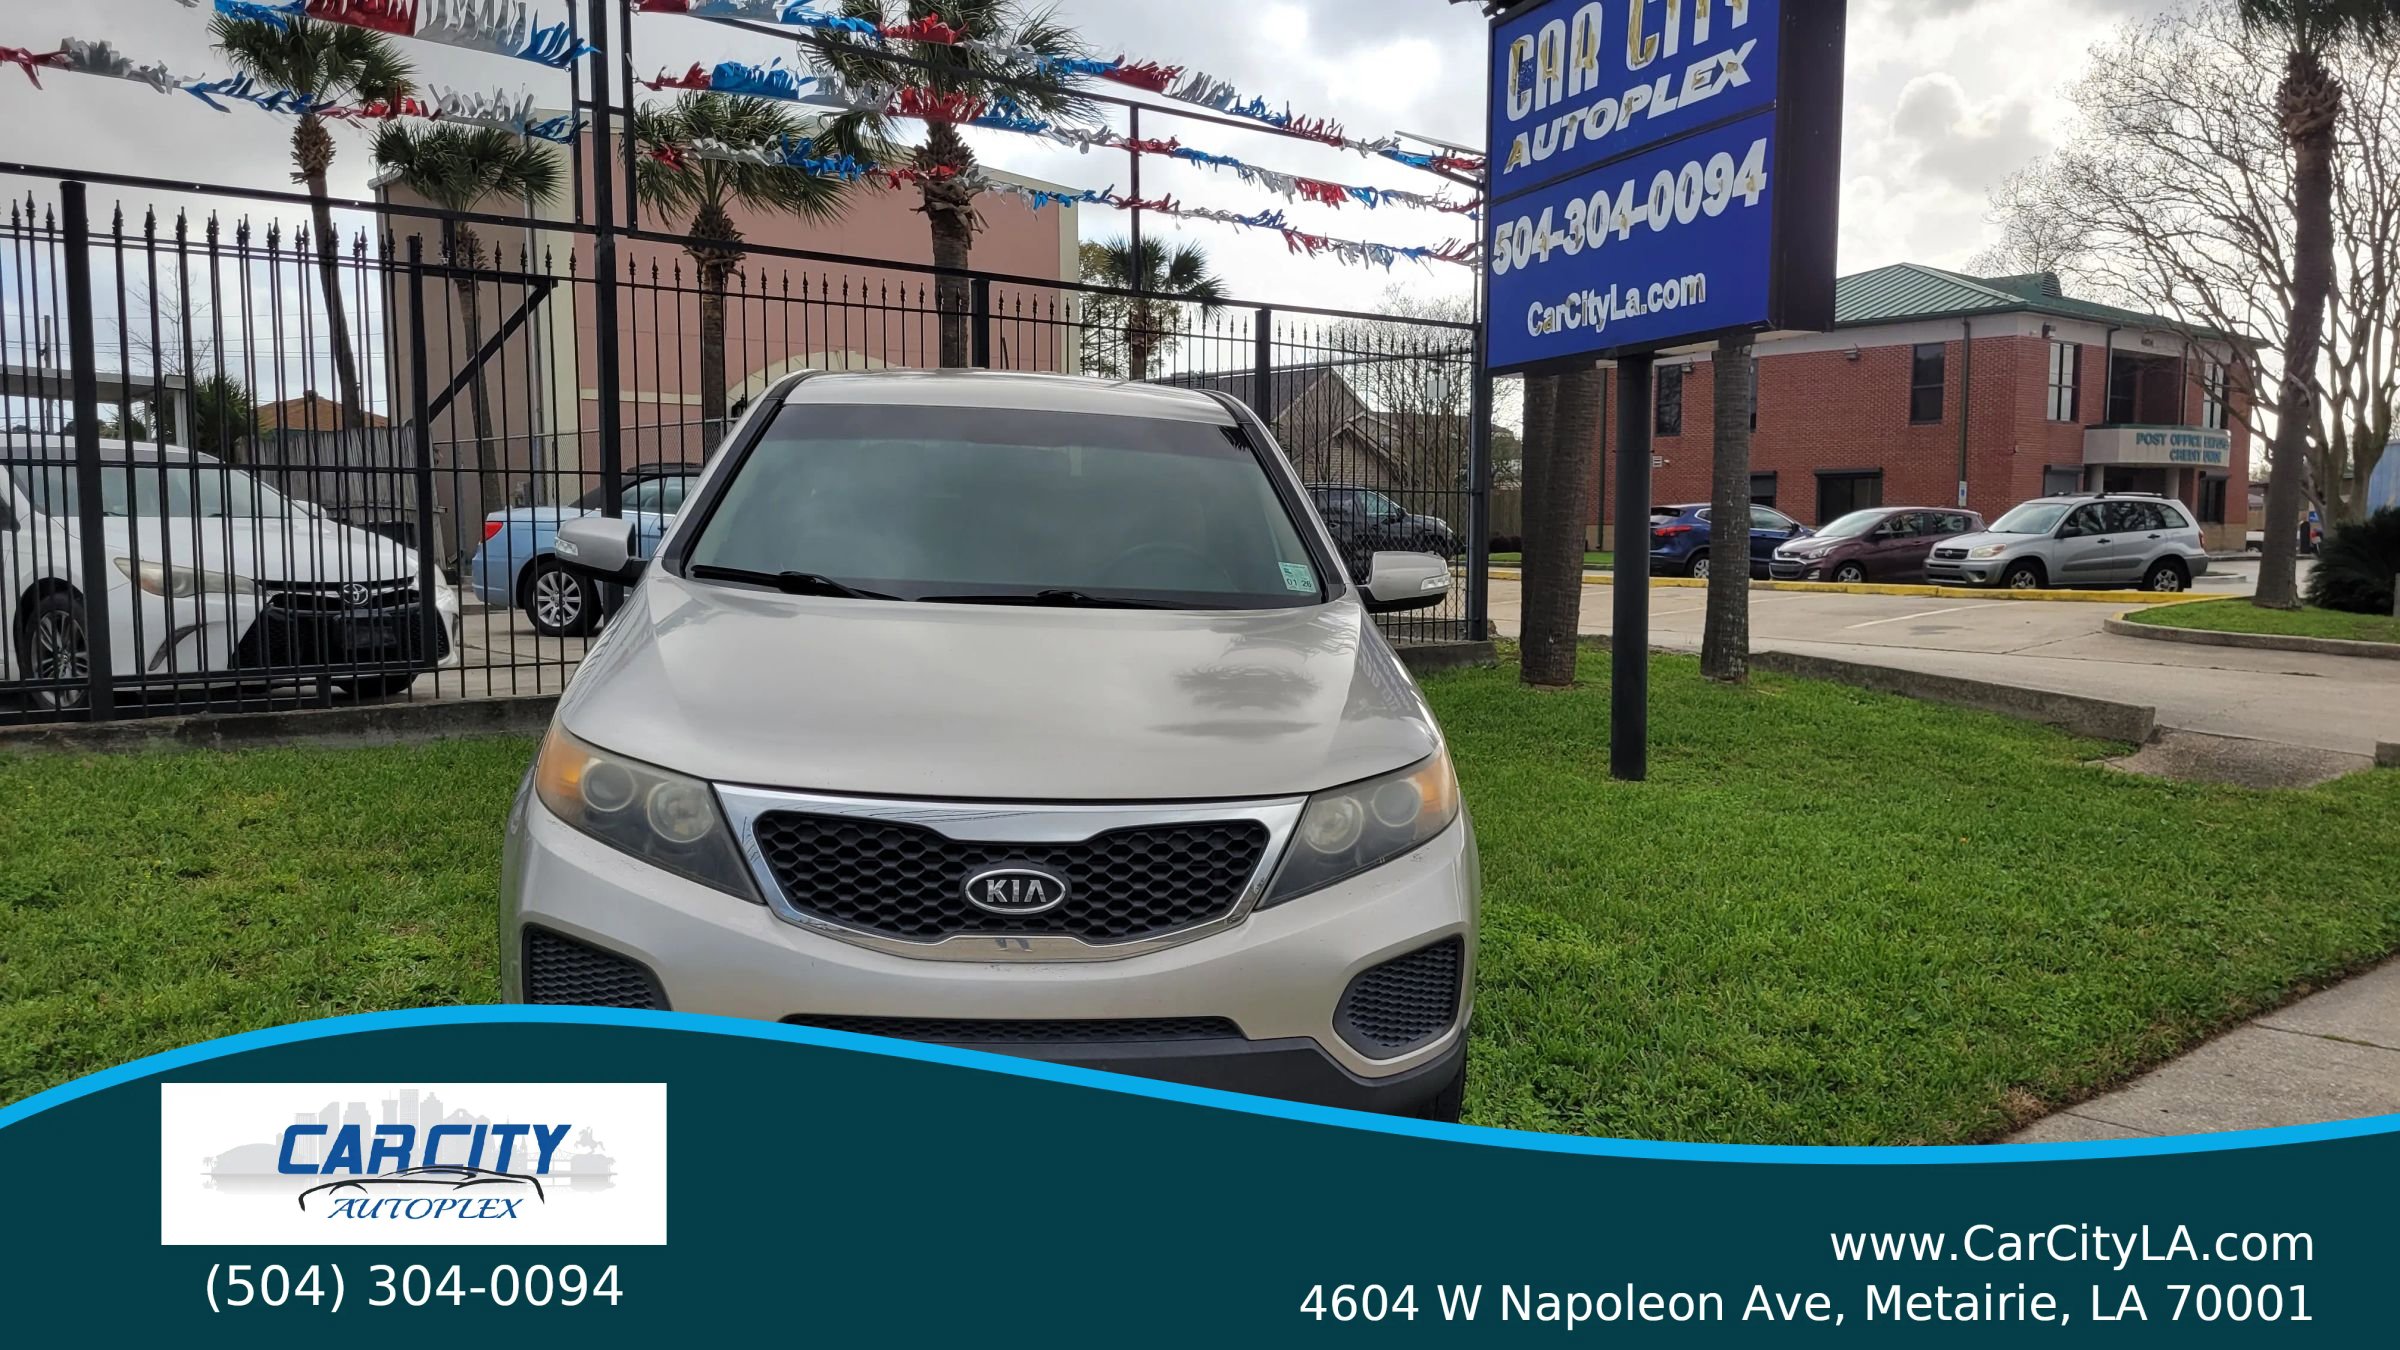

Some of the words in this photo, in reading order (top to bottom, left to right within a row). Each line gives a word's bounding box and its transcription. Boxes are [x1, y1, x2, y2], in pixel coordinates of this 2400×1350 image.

[1503, 38, 1757, 174] AUTOPLEX
[1507, 2, 1603, 121] CAR
[1491, 138, 1767, 275] 504-304-0094
[1527, 272, 1706, 336] CarCityLa.com
[2135, 432, 2167, 446] POST
[986, 880, 1046, 902] KIA
